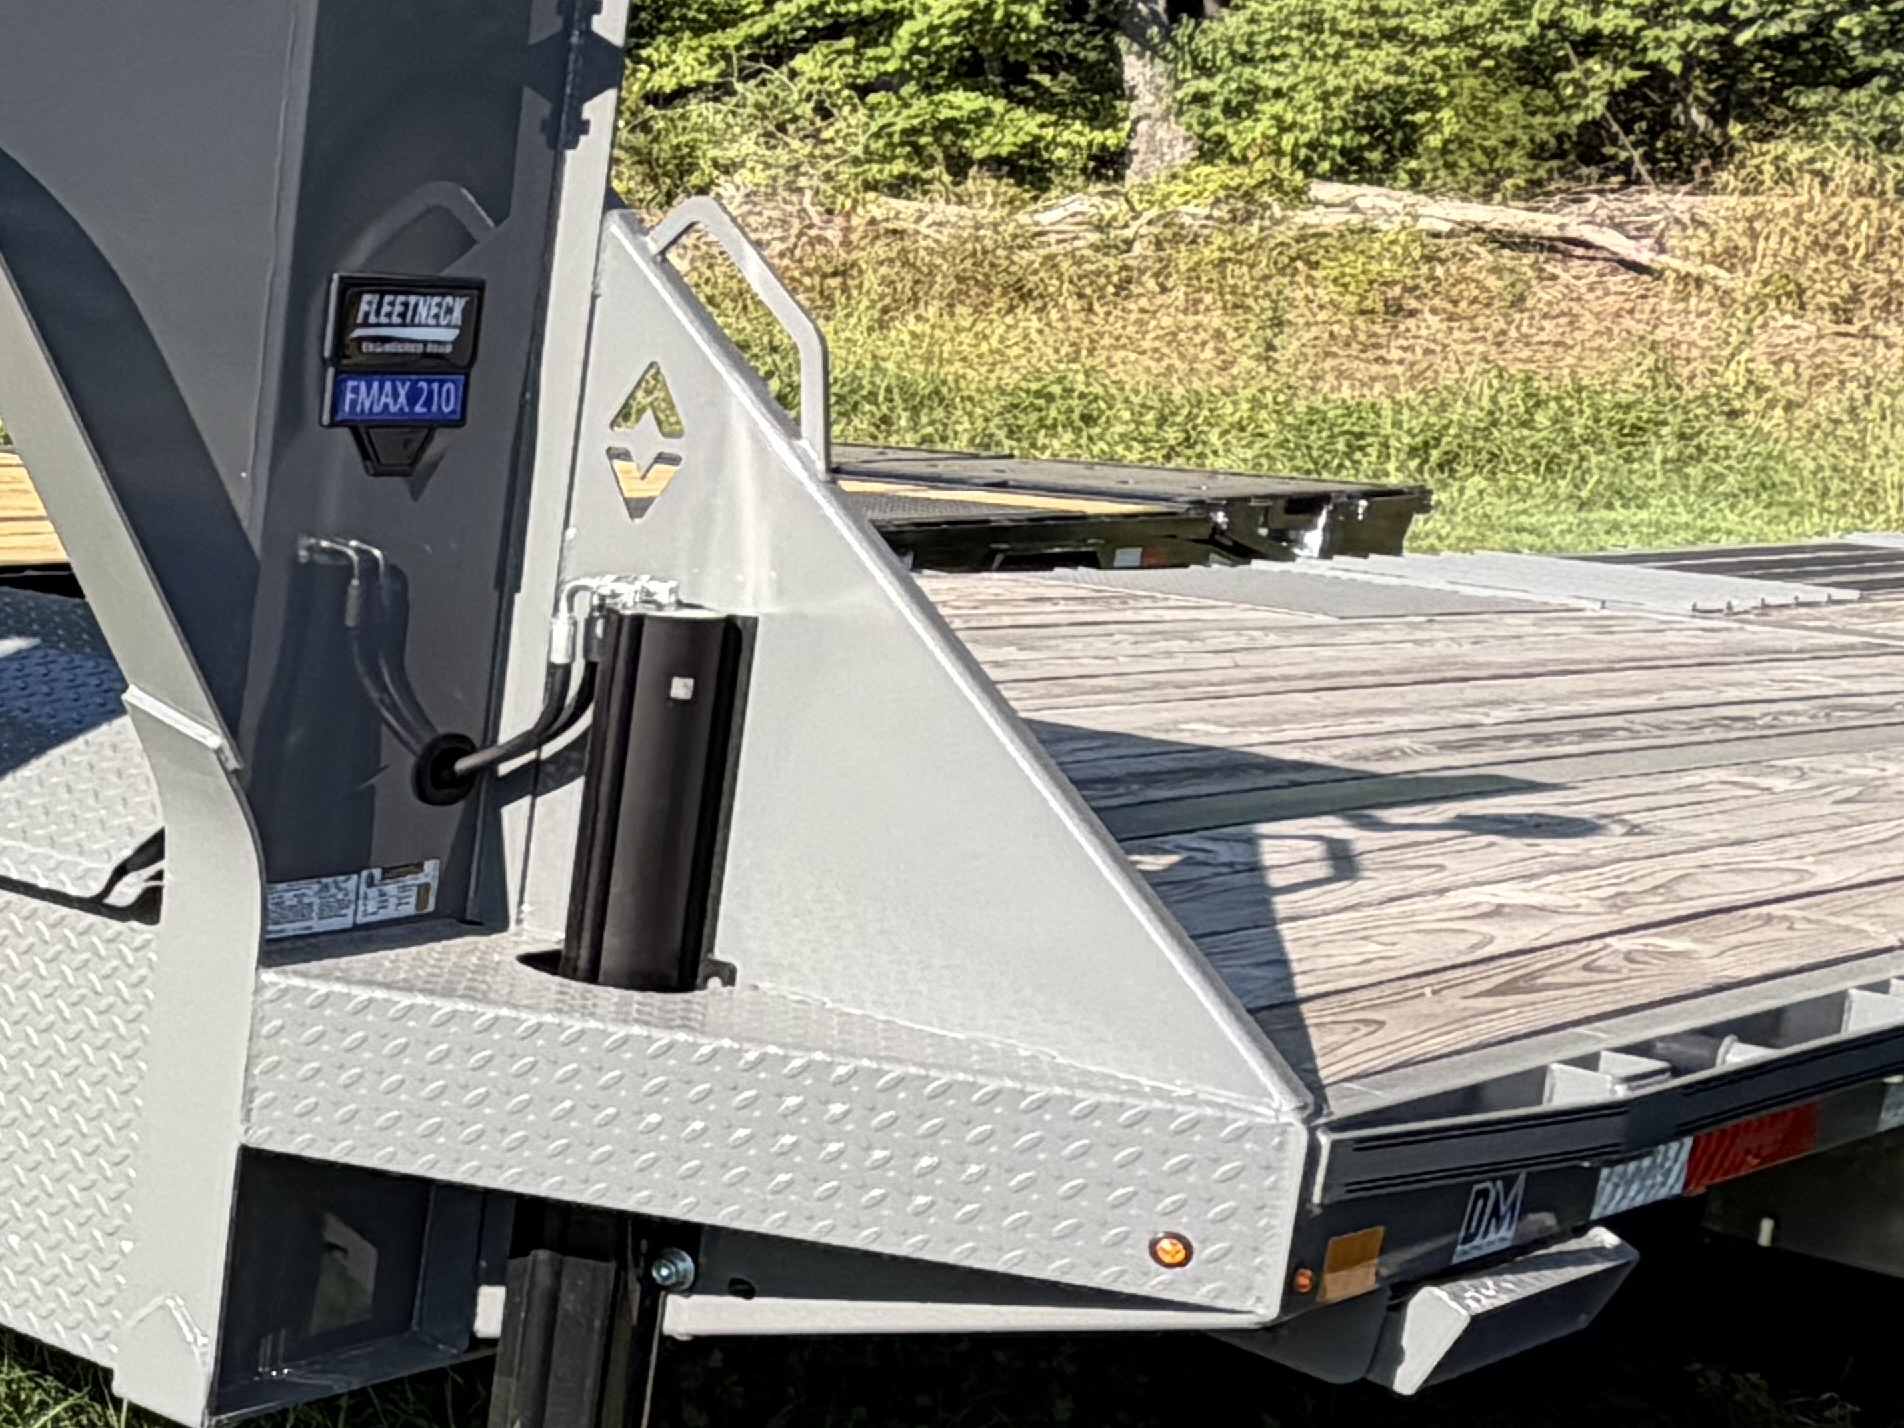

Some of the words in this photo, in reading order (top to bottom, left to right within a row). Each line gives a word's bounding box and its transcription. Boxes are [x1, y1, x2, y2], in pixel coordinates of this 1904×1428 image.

[356, 292, 470, 326] FLEETNECK
[344, 379, 411, 414] FMAX
[414, 380, 456, 414] 210
